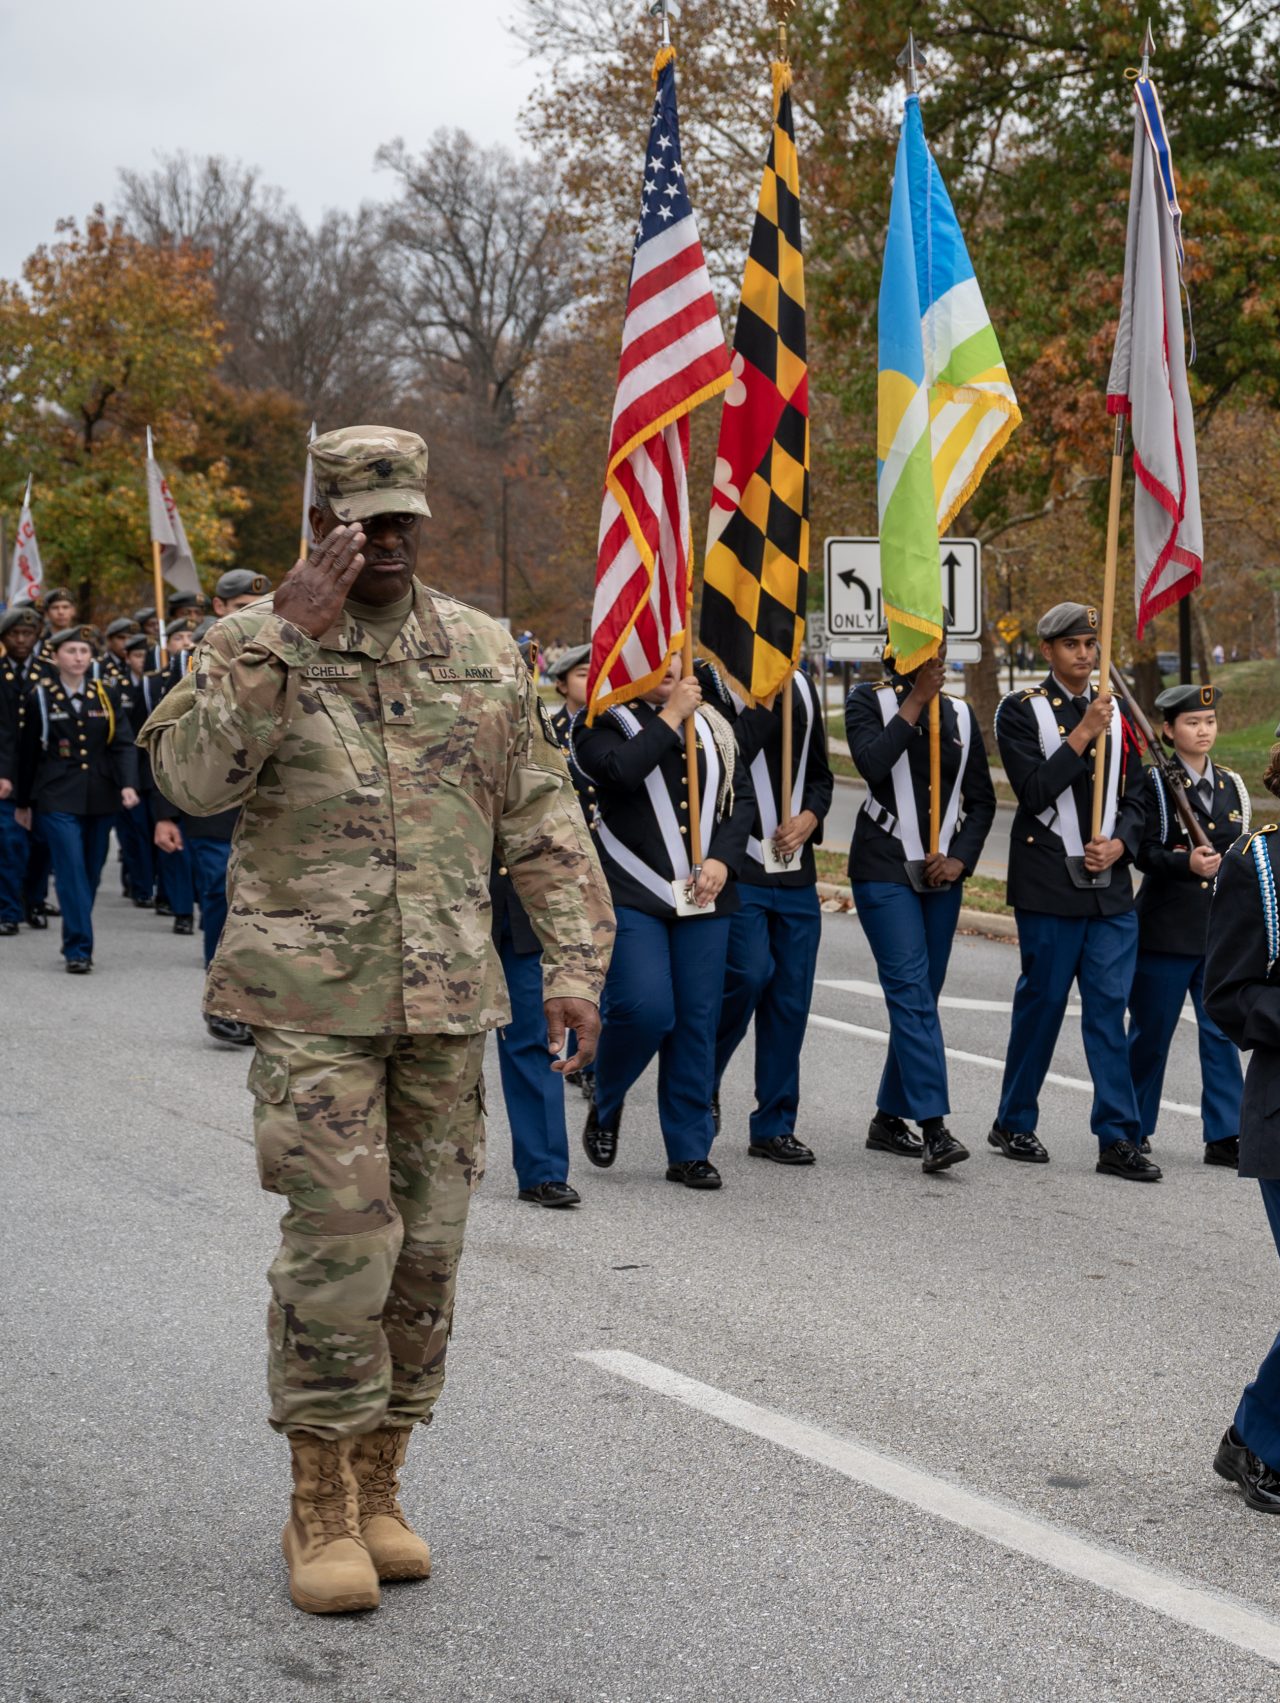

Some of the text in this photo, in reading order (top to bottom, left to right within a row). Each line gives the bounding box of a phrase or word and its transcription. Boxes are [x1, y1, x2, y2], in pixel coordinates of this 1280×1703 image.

[834, 613, 875, 629] ONLY
[438, 668, 493, 679] U.S. ARMY
